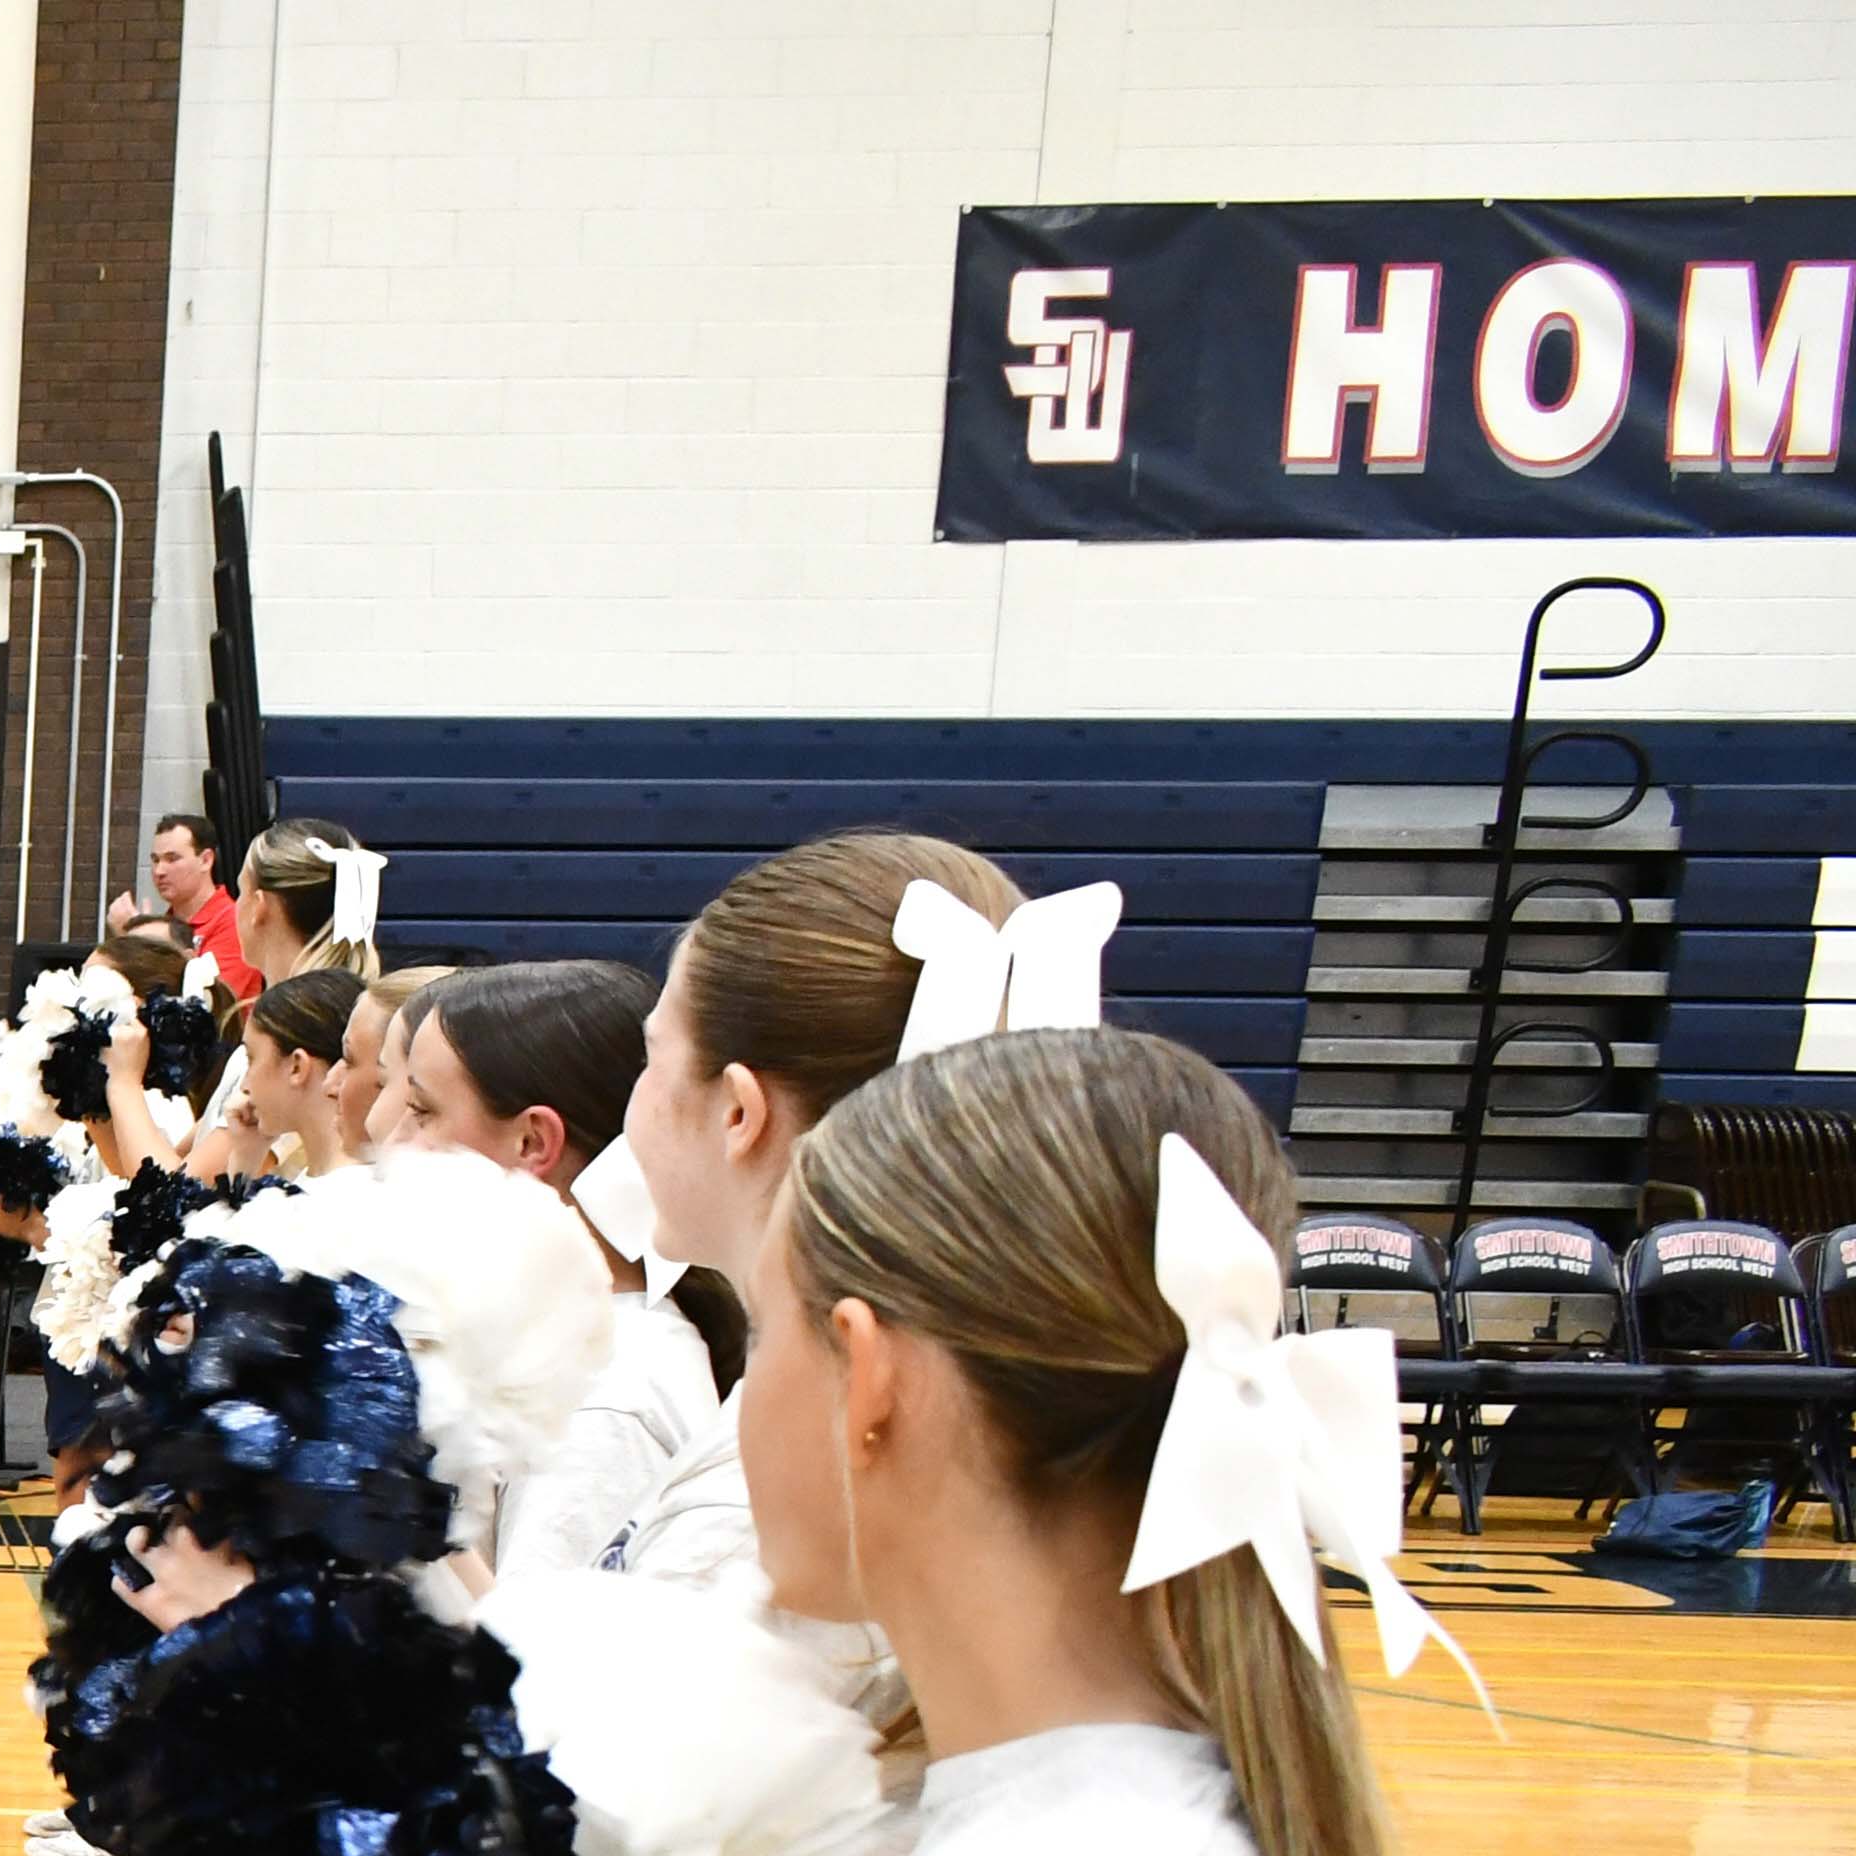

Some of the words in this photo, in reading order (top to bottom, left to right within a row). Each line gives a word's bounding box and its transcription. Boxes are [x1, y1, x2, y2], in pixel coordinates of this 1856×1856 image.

[1280, 256, 1856, 479] HOM
[1296, 1226, 1413, 1261] SMITHTOWN
[1474, 1229, 1593, 1263] SMITHTOWN
[1656, 1231, 1777, 1265] SMITHTOWN
[1301, 1253, 1328, 1270] HIGH
[1329, 1251, 1377, 1266] SCHOOL
[1378, 1256, 1410, 1273] WEST
[1481, 1257, 1508, 1275] HIGH
[1509, 1255, 1557, 1270] SCHOOL
[1558, 1259, 1591, 1276] WEST
[1662, 1258, 1689, 1275] HIGH
[1691, 1256, 1739, 1272] SCHOOL
[1741, 1261, 1775, 1279] WEST
